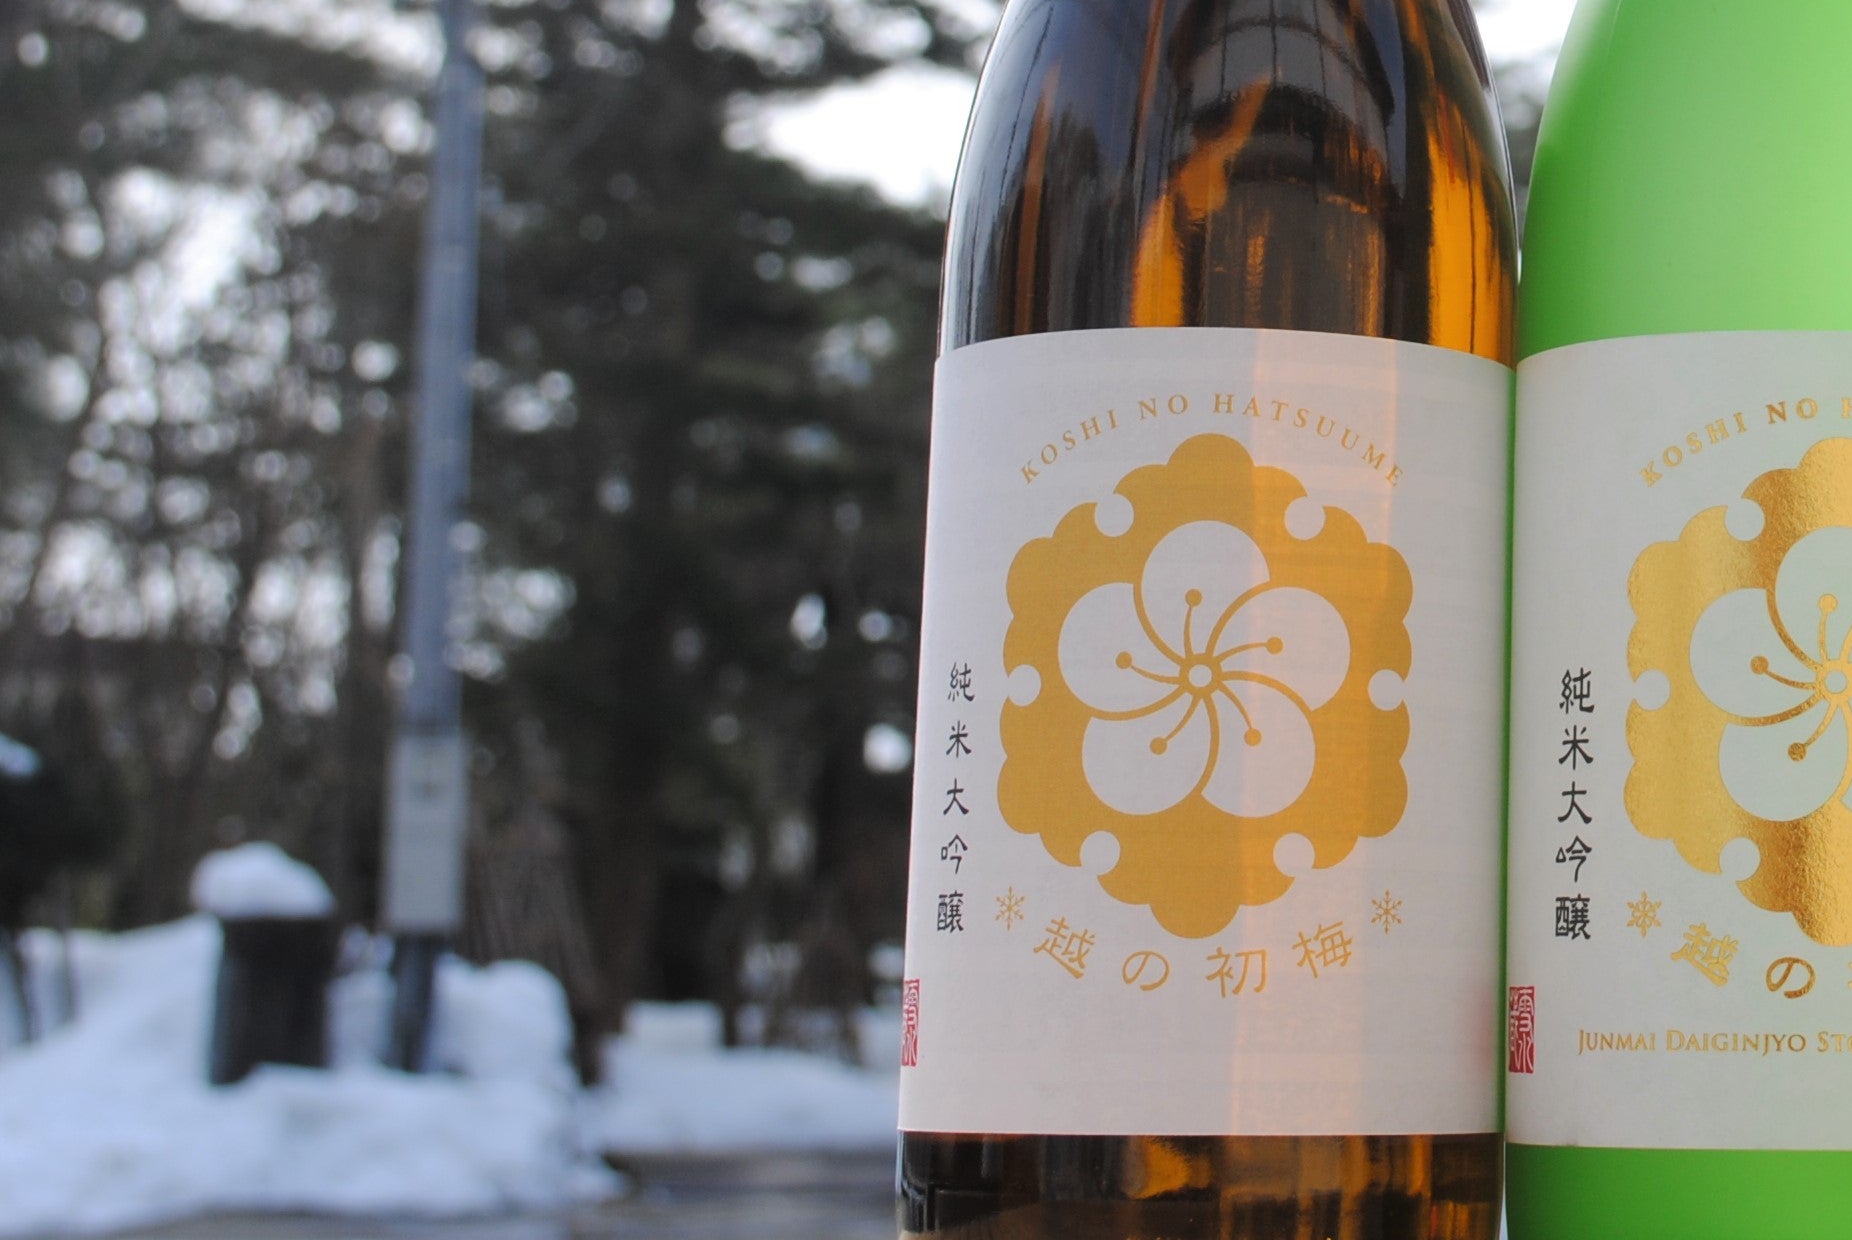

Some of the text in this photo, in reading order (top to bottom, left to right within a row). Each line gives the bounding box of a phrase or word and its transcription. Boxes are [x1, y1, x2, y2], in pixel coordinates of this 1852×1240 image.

[1018, 393, 1404, 488] KOSHI NO HATSUUME
[1638, 412, 1749, 489] KOSHI
[1765, 398, 1818, 424] NO
[936, 661, 976, 935] 純米大吟醸
[1554, 667, 1595, 941] 純米大吟醸
[1033, 915, 1354, 999] 越の初梅
[1577, 1029, 1657, 1055] JUNMAI
[1666, 1029, 1807, 1056] DAIGINJYO
